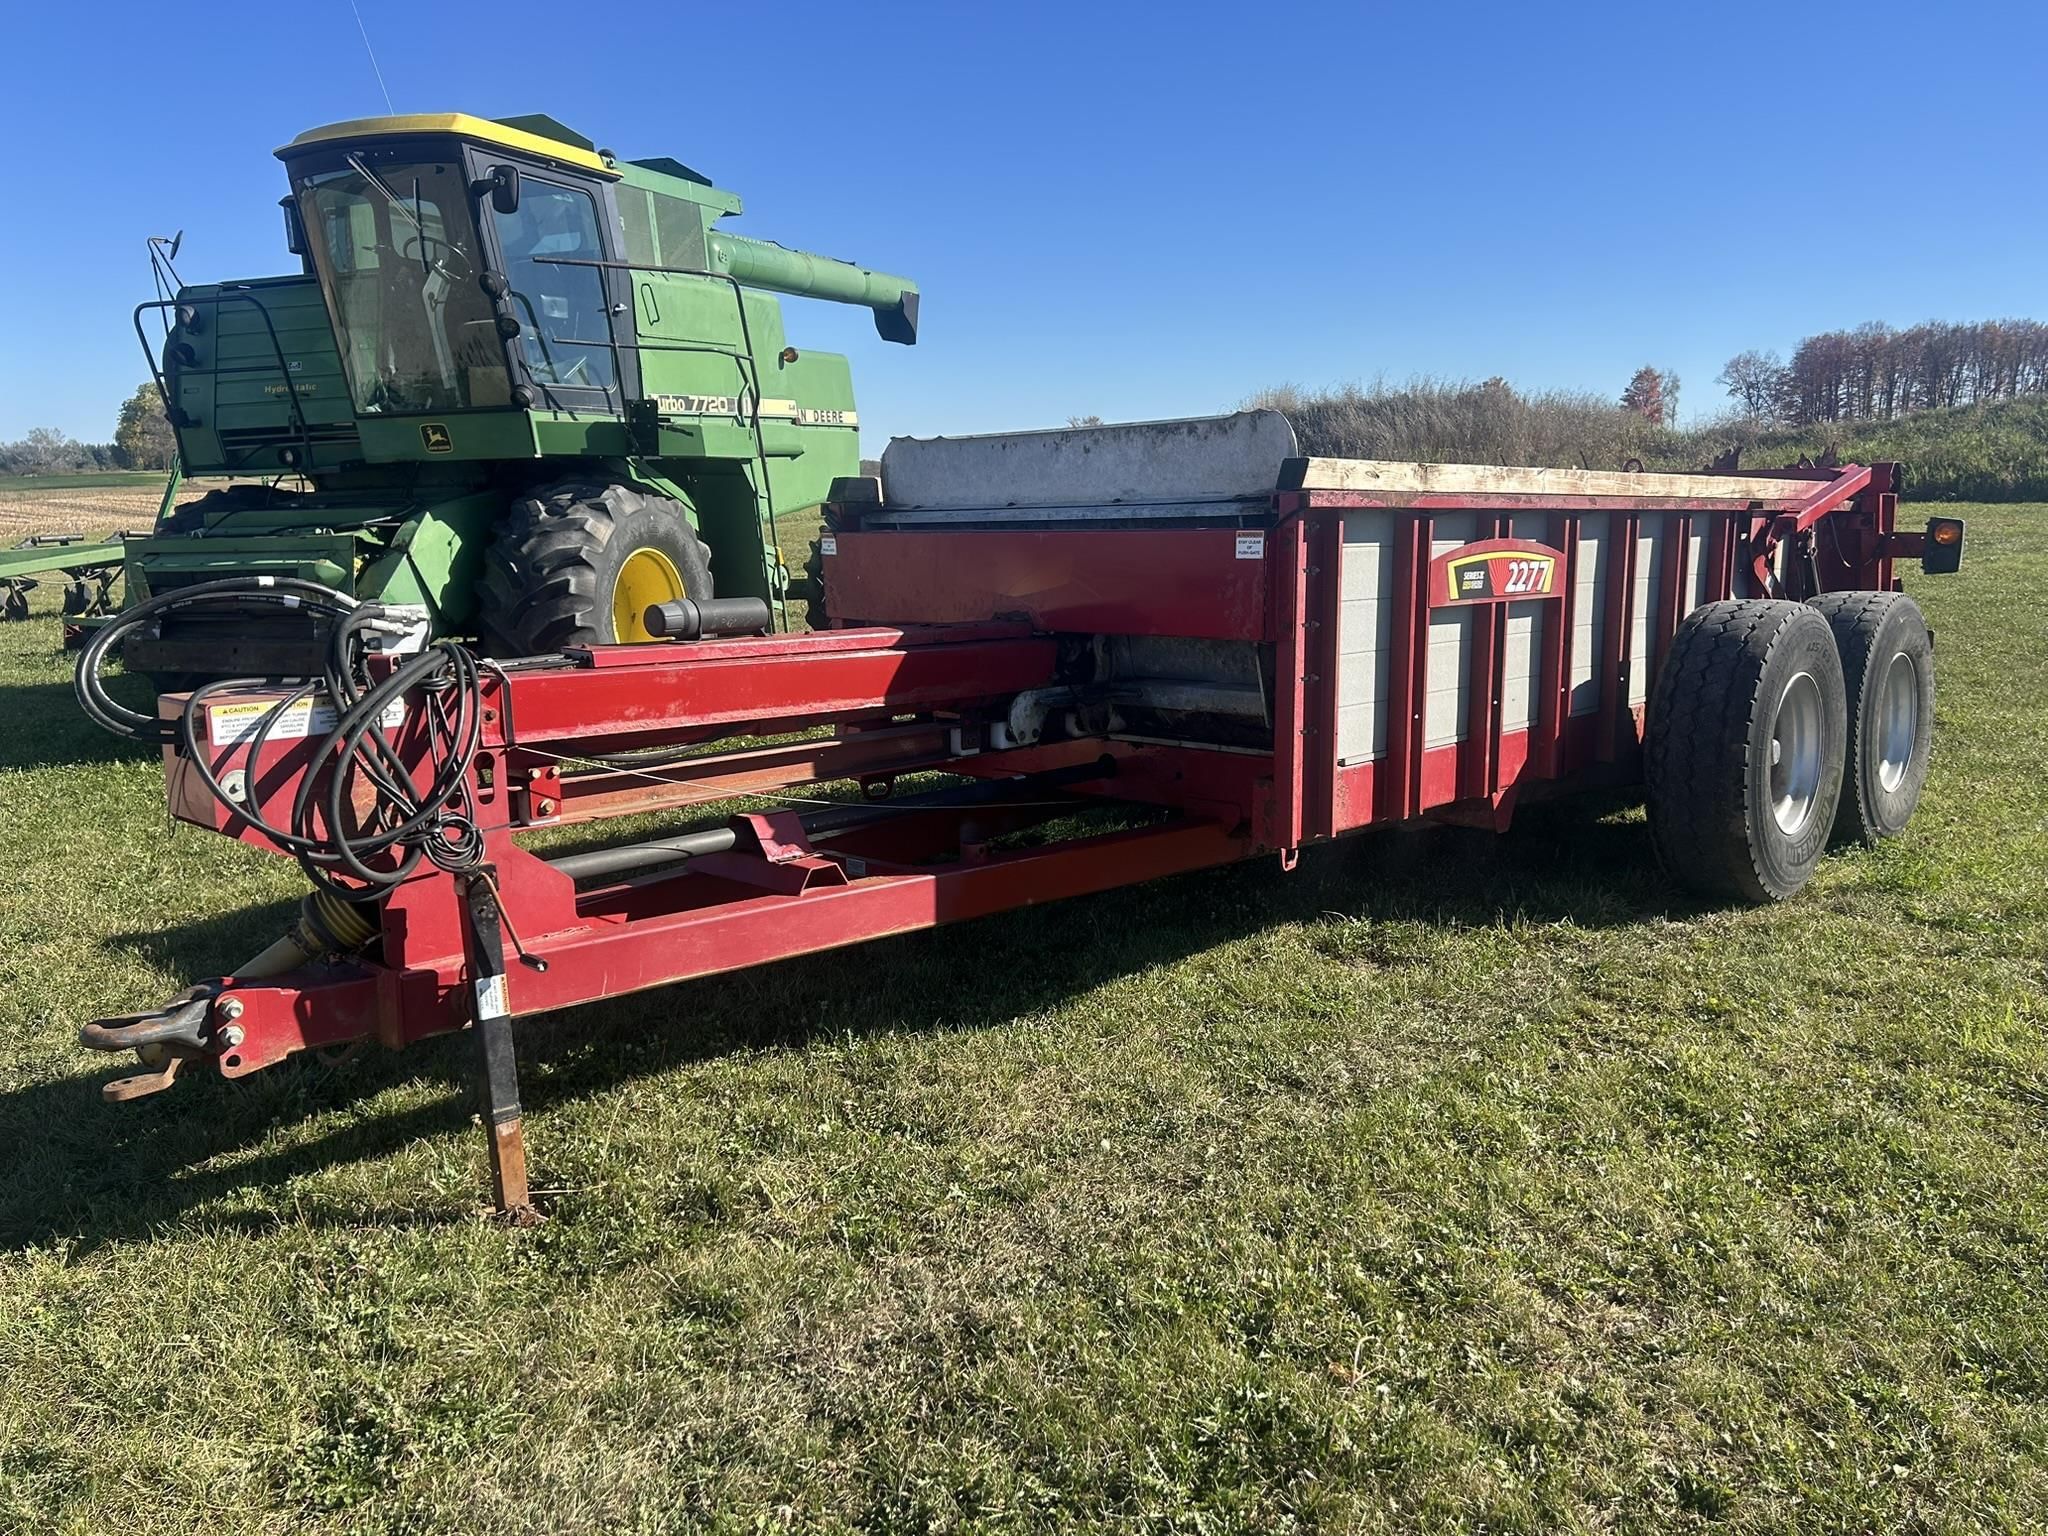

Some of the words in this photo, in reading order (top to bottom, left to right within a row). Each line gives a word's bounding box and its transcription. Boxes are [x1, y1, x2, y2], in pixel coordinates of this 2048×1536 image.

[264, 384, 318, 394] Hydrtatic
[687, 395, 729, 414] 7720
[813, 405, 844, 424] DEERE
[1504, 561, 1550, 593] 2277
[228, 706, 259, 714] CAUTION
[1786, 798, 1835, 866] MICHELIN
